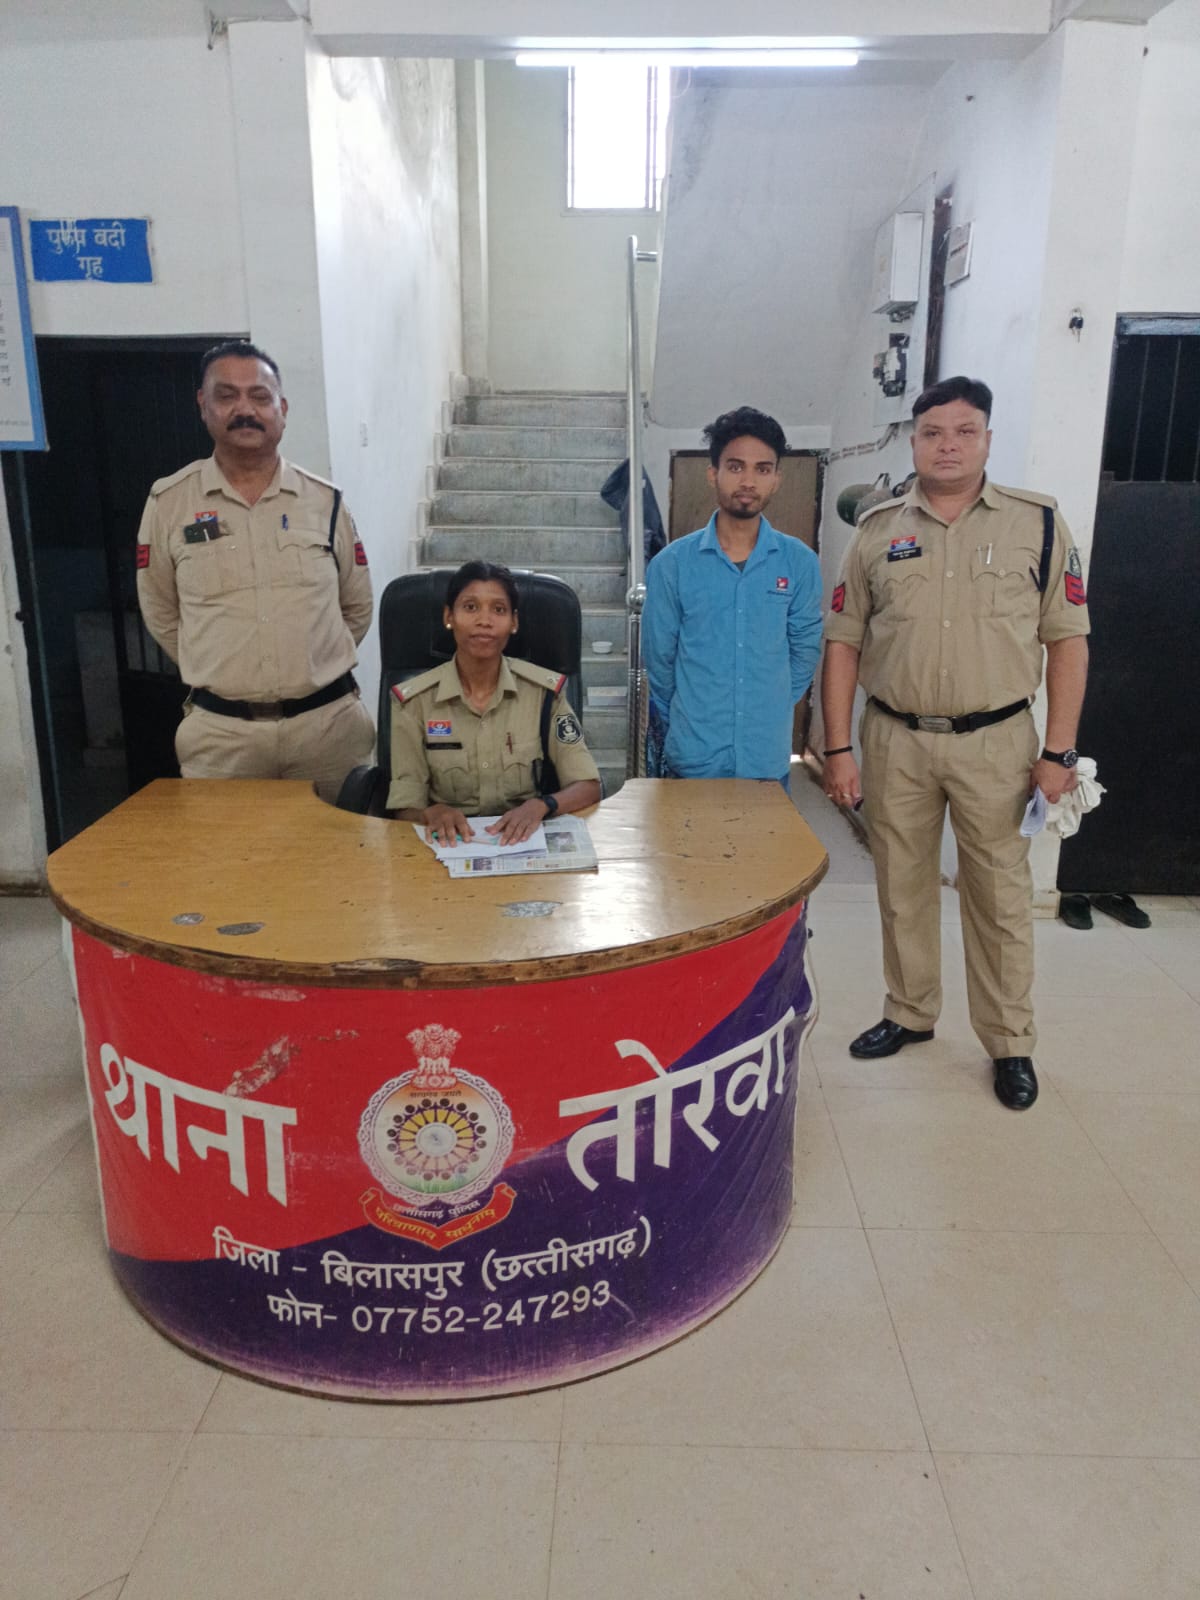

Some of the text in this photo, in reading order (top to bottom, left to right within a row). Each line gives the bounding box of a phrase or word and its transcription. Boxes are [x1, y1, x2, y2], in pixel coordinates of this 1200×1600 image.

[100, 1006, 795, 1208] थाना तोरवा
[212, 1225, 281, 1276] जिला
[320, 1250, 465, 1299] बिलासपुर
[351, 1279, 611, 1334] 07752-247293
